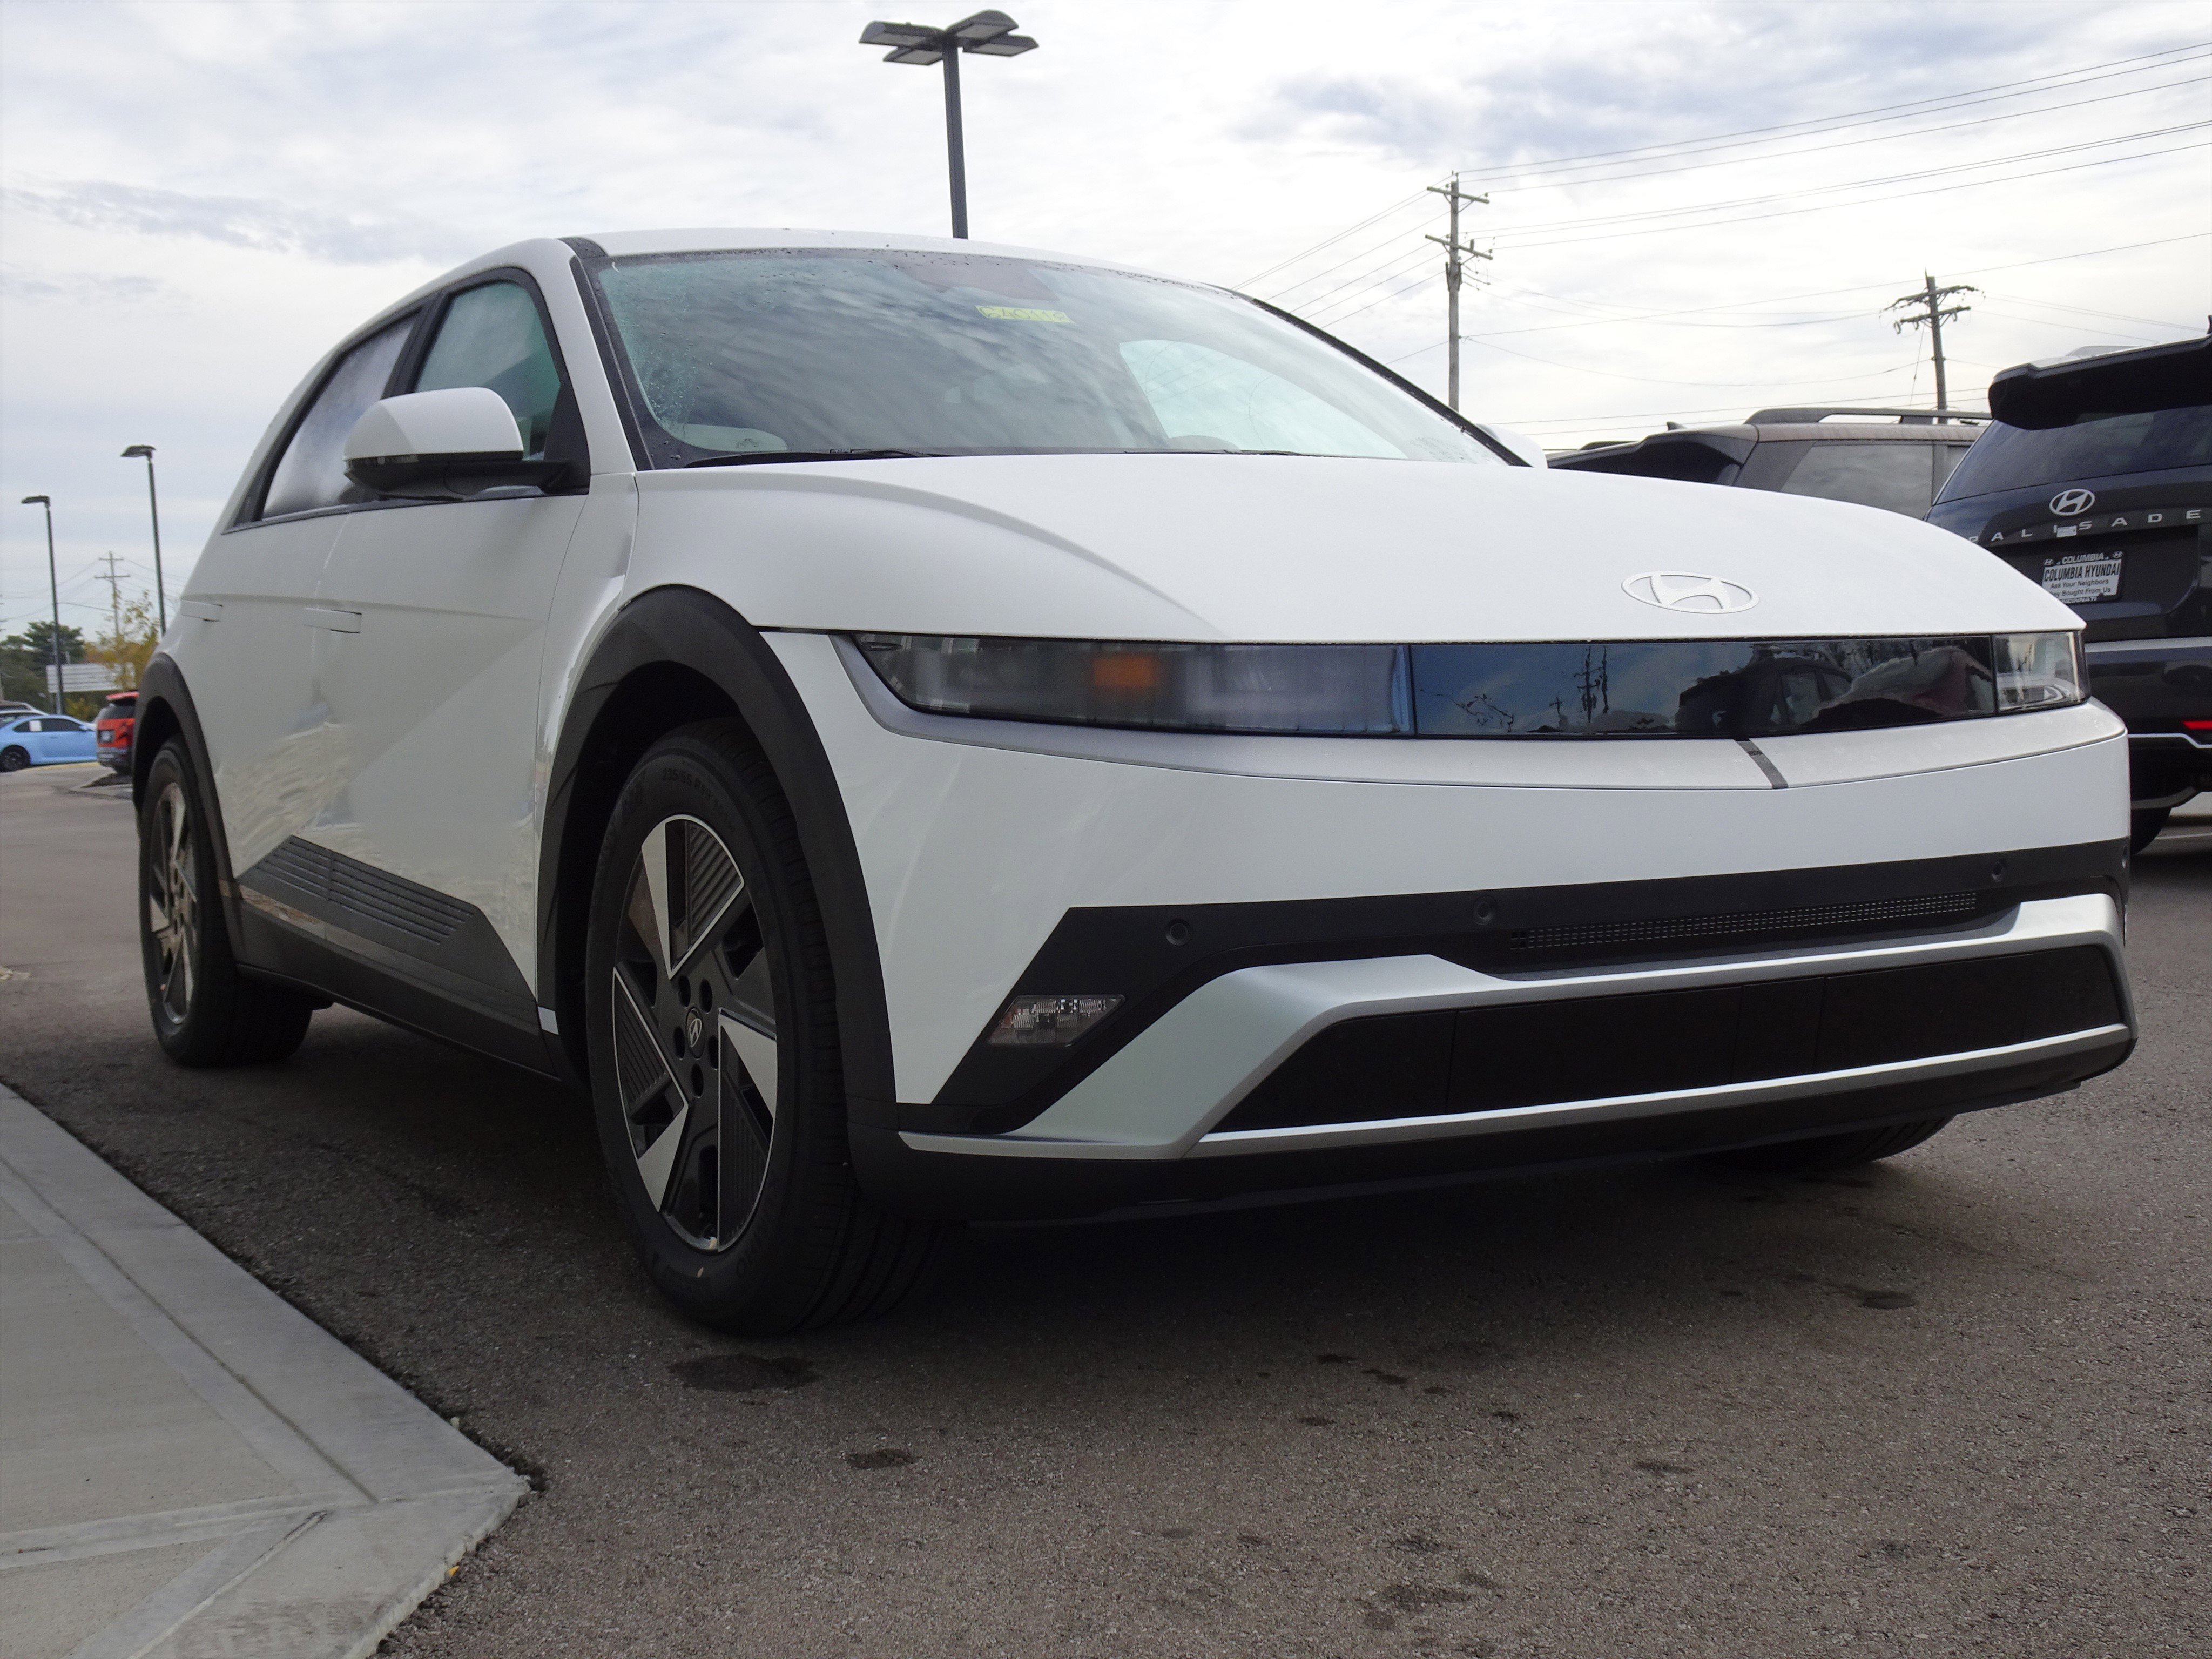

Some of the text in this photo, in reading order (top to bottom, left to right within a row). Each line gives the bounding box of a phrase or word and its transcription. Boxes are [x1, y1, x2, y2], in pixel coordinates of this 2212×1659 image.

[1969, 509, 2201, 542] PALISADE
[2062, 552, 2104, 564] COLUMBIA
[2044, 563, 2120, 582] COLUMBIA HYUNDAI
[2077, 578, 2109, 587] Neighbors
[2062, 588, 2084, 597] Bought
